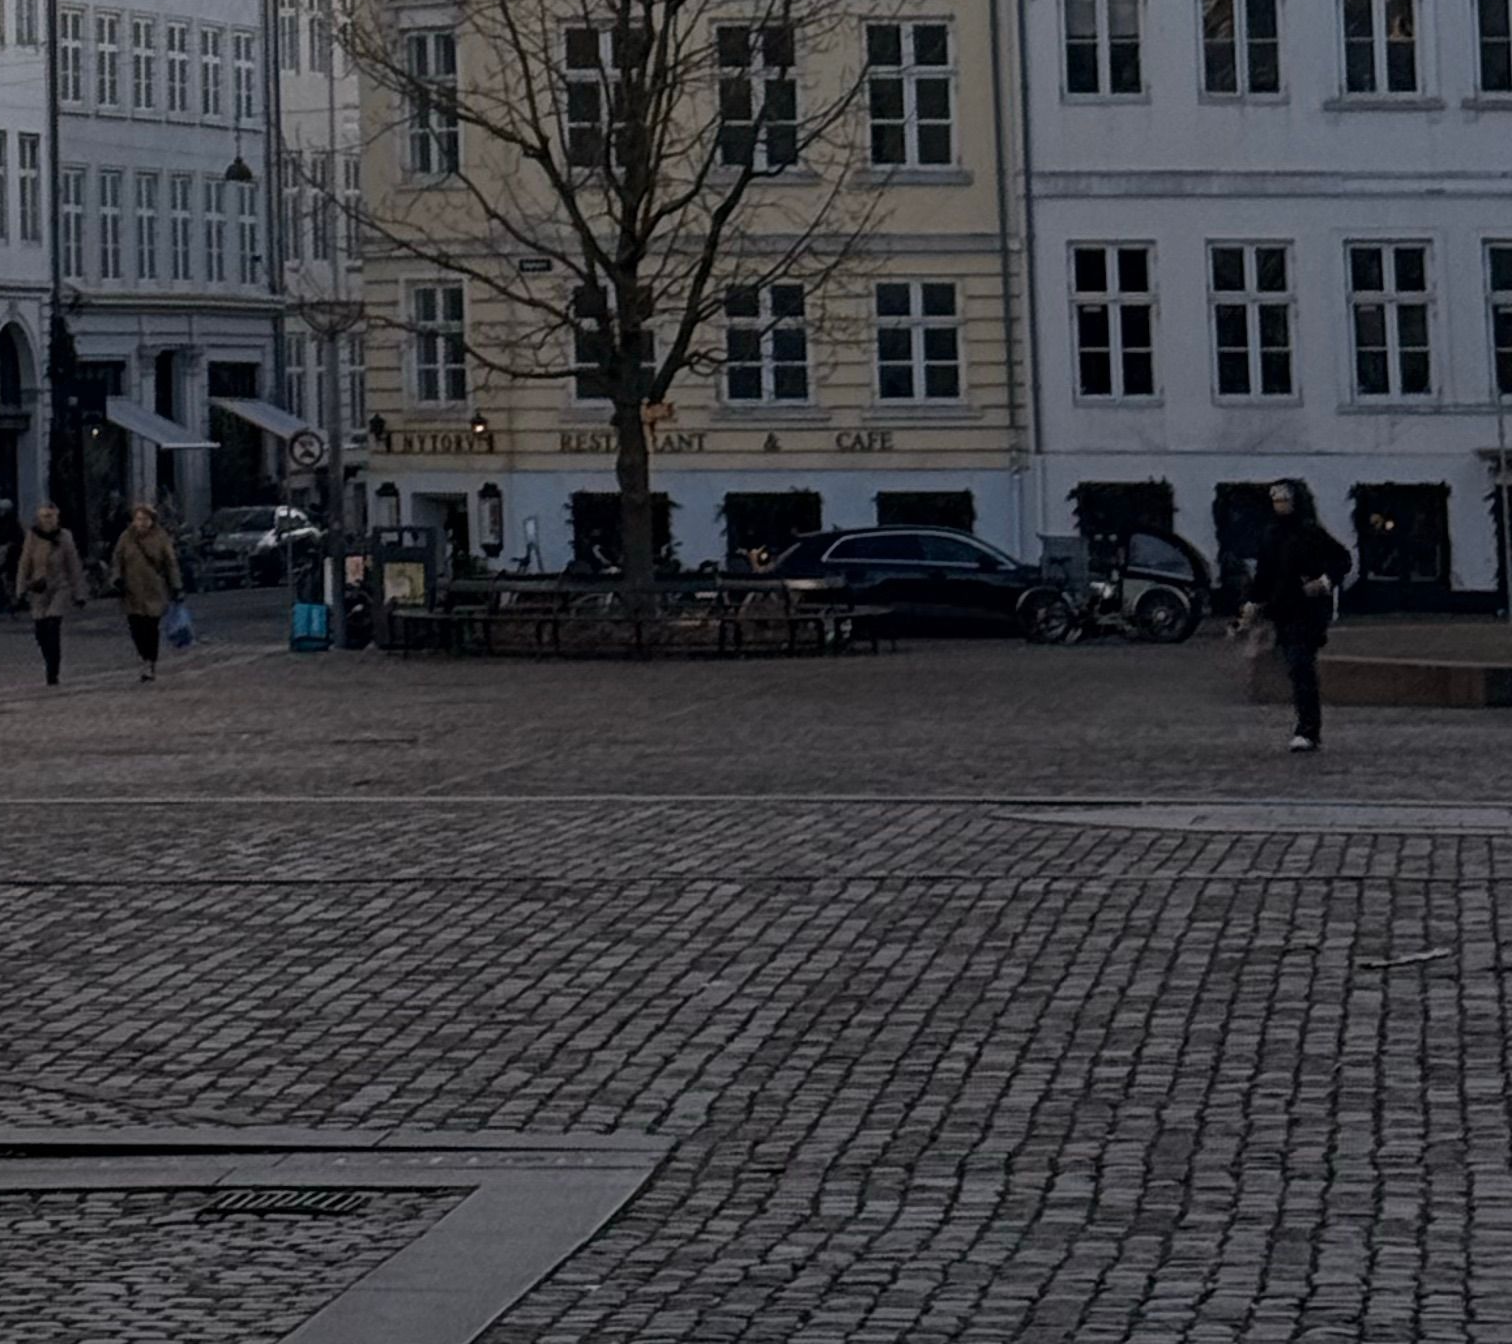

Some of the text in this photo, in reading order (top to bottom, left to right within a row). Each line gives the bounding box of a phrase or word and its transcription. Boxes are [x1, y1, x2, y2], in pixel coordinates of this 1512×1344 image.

[403, 433, 474, 453] NYTORV
[559, 432, 894, 453] RESTANT & CAFE
